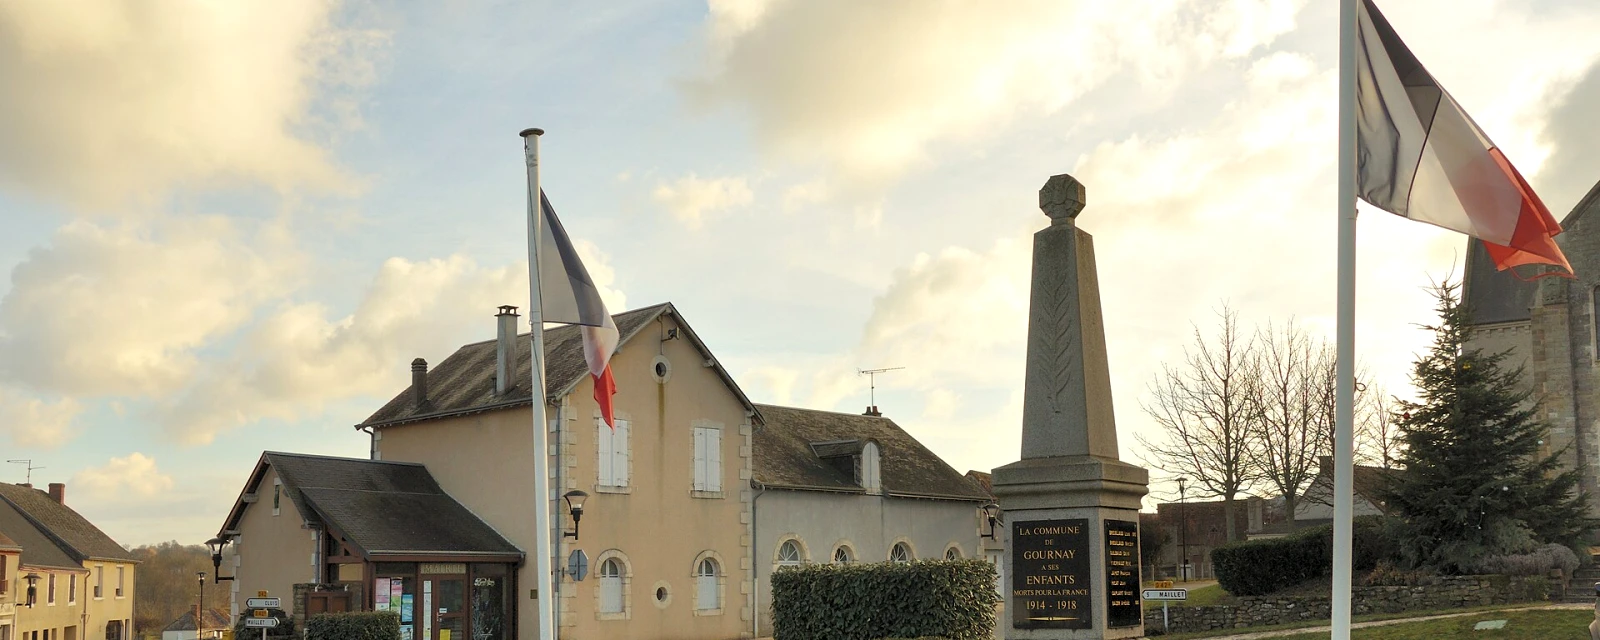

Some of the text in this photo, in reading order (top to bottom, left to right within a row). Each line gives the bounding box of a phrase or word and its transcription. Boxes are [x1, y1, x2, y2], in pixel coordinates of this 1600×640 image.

[1034, 526, 1080, 535] COMMUNE
[1024, 550, 1076, 560] GOURNAY
[1026, 574, 1075, 584] ENFANTS
[1026, 600, 1045, 610] 1914
[1057, 600, 1077, 609] 1918
